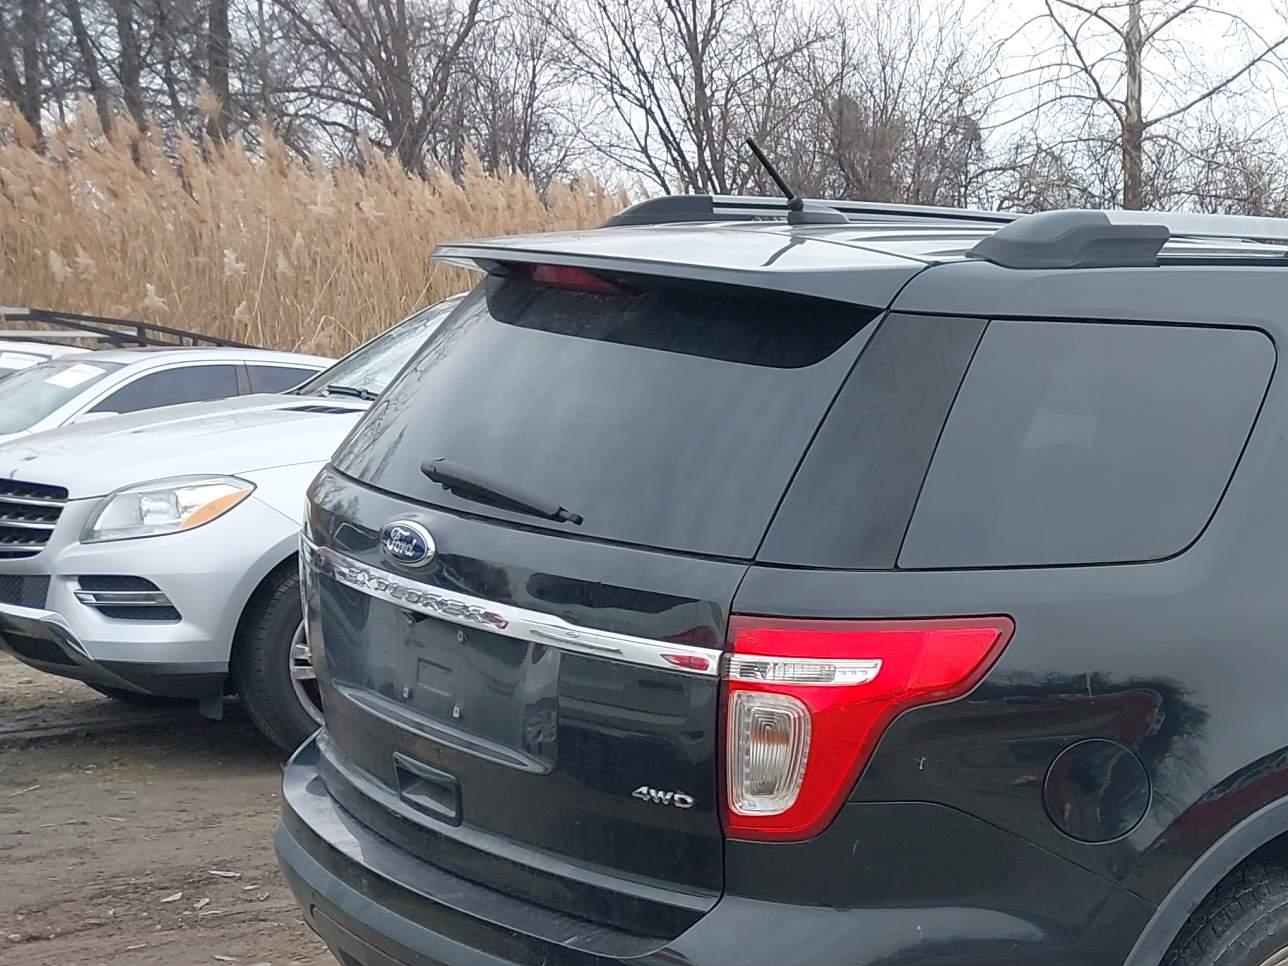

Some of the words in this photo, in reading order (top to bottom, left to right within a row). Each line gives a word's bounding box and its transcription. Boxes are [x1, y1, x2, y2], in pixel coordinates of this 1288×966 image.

[386, 526, 417, 557] Ford
[345, 567, 509, 630] EXPLORER
[632, 786, 694, 808] 4WD
